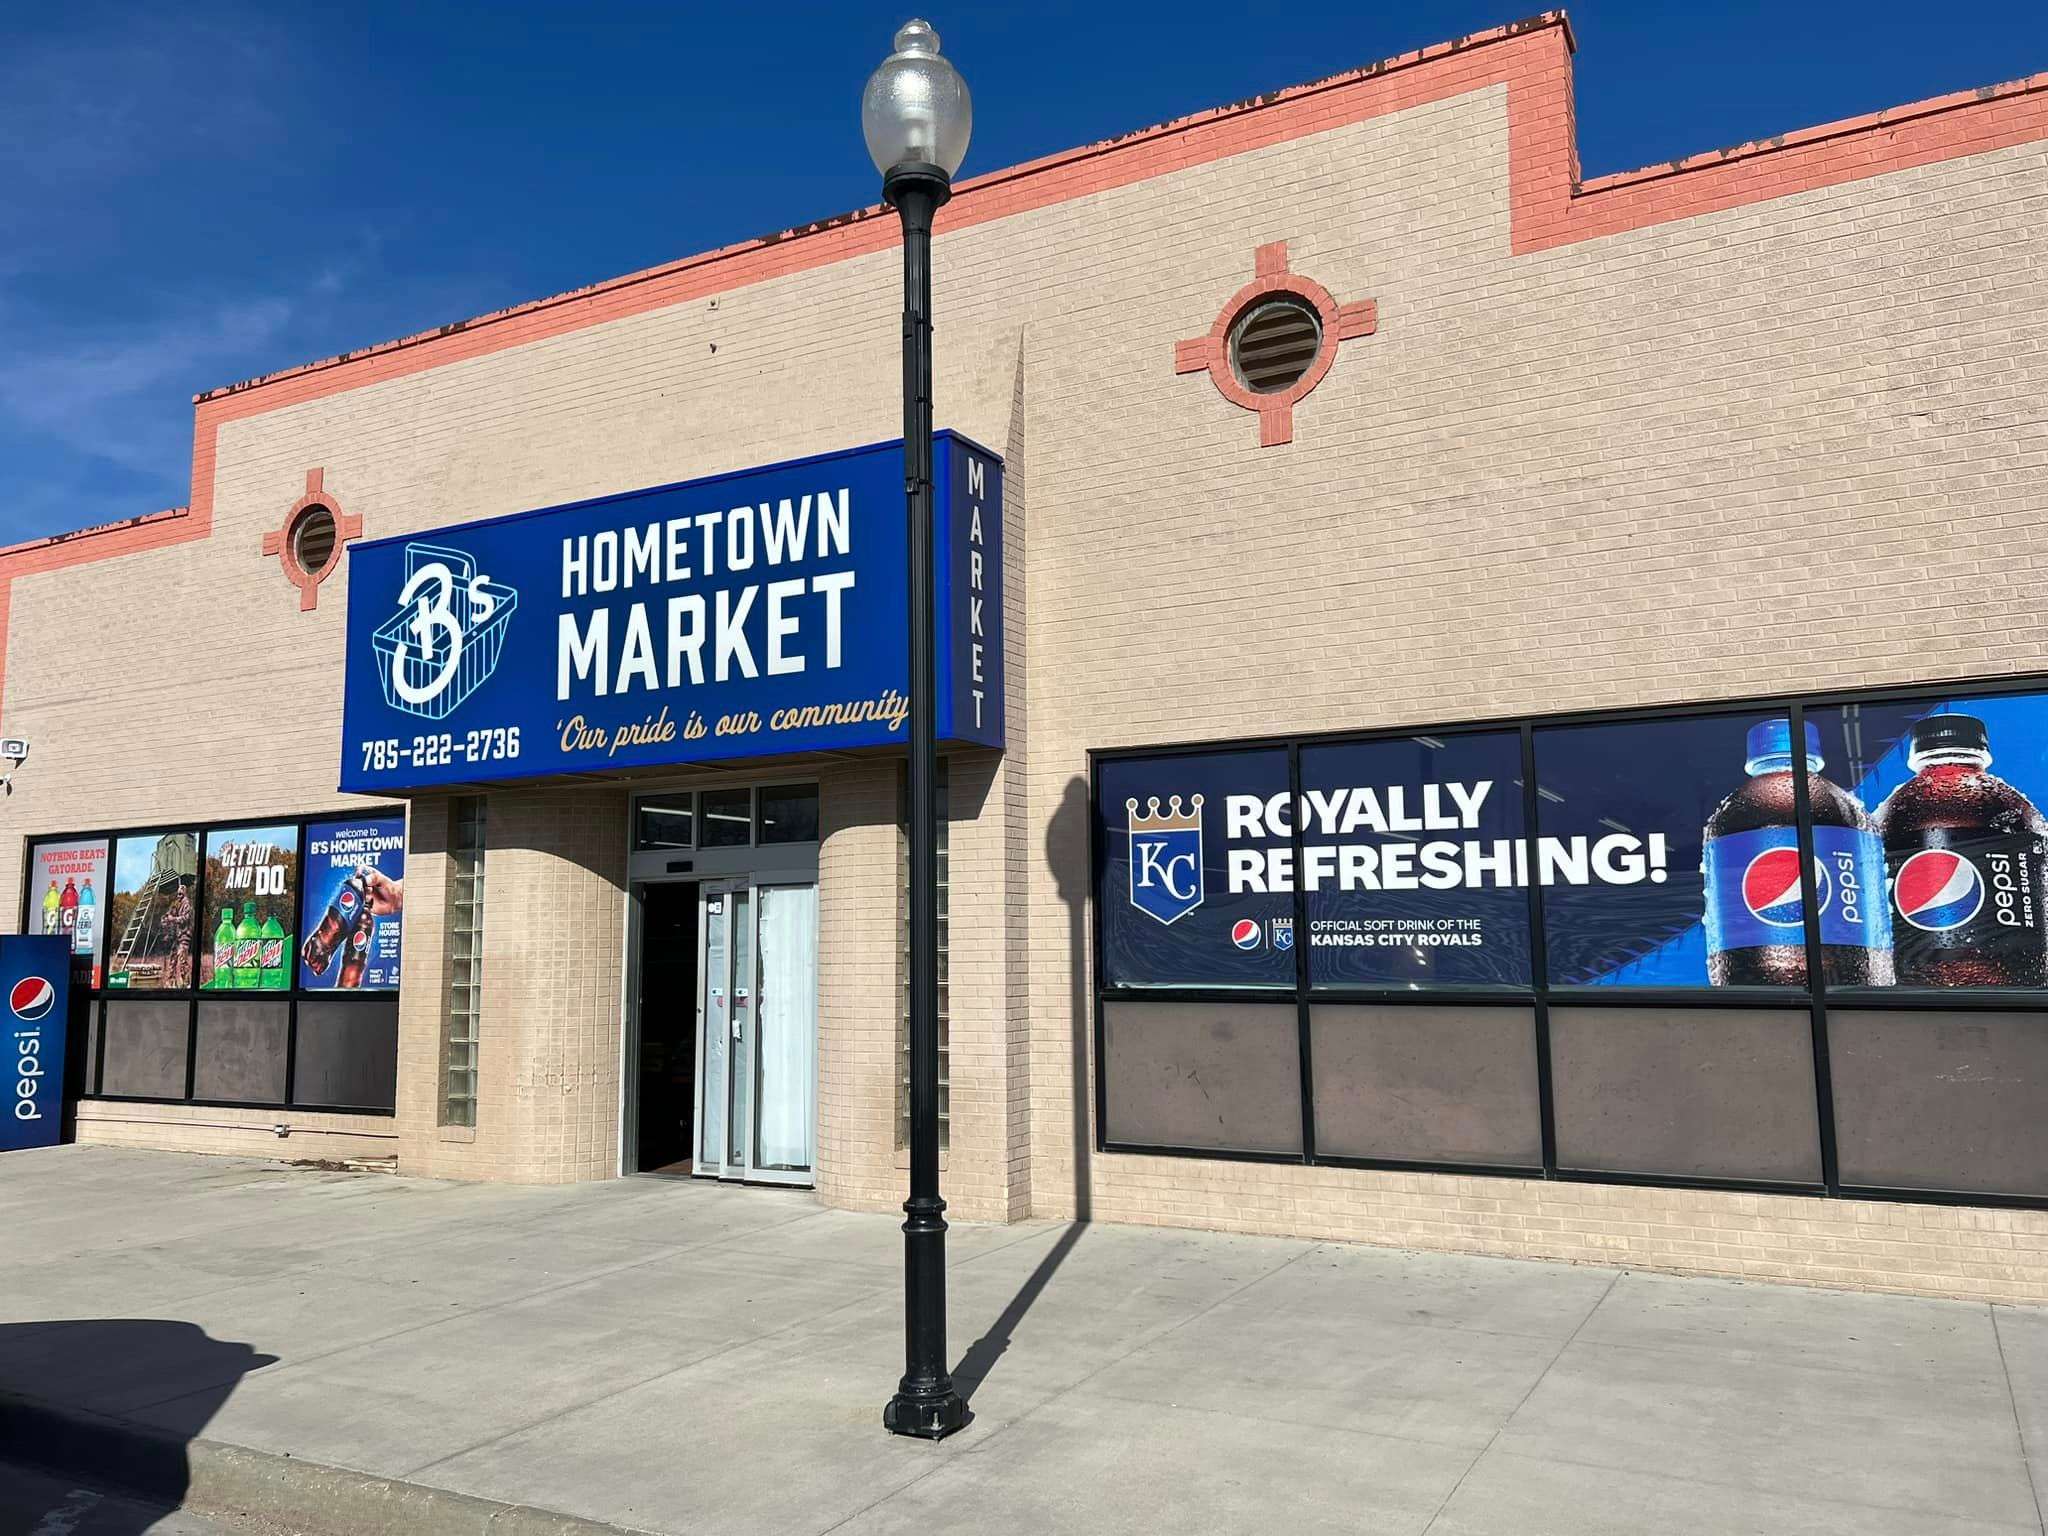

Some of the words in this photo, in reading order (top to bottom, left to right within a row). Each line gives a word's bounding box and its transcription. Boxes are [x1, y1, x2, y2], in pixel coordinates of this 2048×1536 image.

[562, 487, 850, 598] HOMETOWN
[968, 456, 984, 729] MARKET
[557, 570, 855, 701] MARKET
[608, 705, 676, 757] pride
[683, 710, 707, 741] is
[714, 710, 762, 737] our
[770, 688, 910, 732] community
[362, 726, 520, 772] 785-222-2736
[1225, 780, 1494, 839] ROYALLY
[311, 841, 329, 855] B'S
[330, 836, 403, 854] HOMETOWN
[335, 828, 369, 838] welcome
[369, 827, 378, 836] to
[40, 849, 78, 863] NOTHING
[79, 848, 106, 860] BEATS
[221, 843, 247, 867] GET
[246, 842, 273, 866] OUT
[330, 852, 381, 868] MARKET
[1136, 842, 1197, 900] KC
[1227, 832, 1668, 894] REFRESHING!
[2018, 852, 2031, 894] SUGAR
[225, 866, 253, 889] AND
[1832, 851, 1864, 923] pepsi
[1985, 853, 2022, 926] pepsi
[63, 908, 73, 927] G
[1310, 920, 1362, 932] OFFICIAL
[1363, 920, 1395, 931] SOFT
[1397, 919, 1435, 931] DRINK
[1436, 919, 1456, 930] OF
[1457, 919, 1481, 930] THE
[2022, 895, 2034, 928] ZERO
[1276, 930, 1292, 945] KC
[1311, 934, 1375, 946] KANSAS
[1377, 934, 1416, 946] CITY
[1417, 933, 1482, 946] ROYALS
